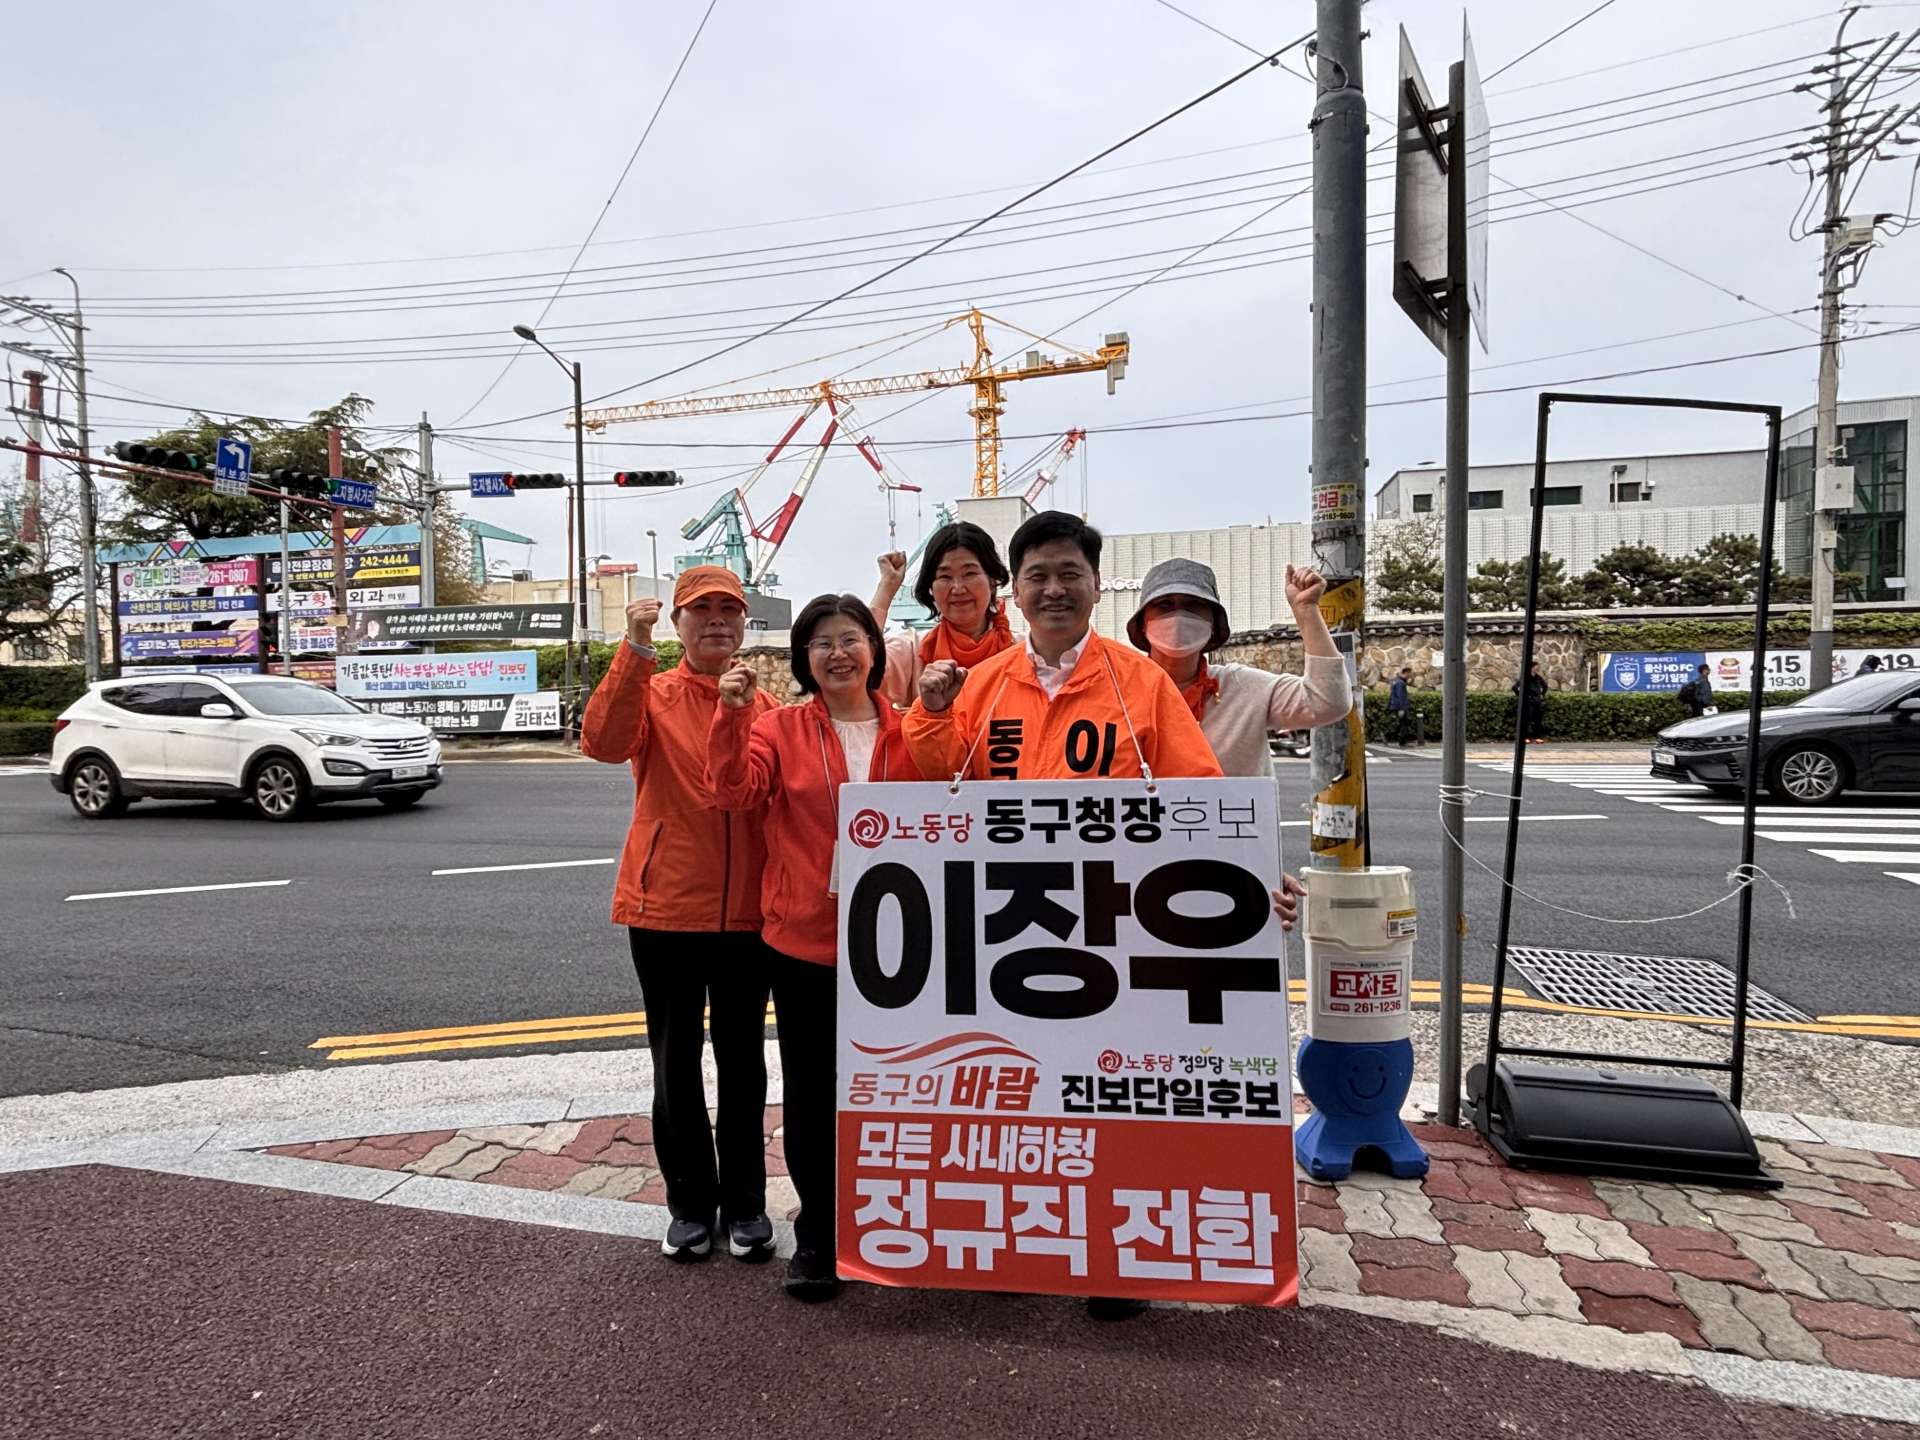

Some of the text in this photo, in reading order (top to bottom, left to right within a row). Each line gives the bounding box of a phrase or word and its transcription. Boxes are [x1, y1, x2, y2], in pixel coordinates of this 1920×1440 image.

[217, 466, 248, 480] 비보호
[359, 554, 409, 567] 242-4444
[191, 599, 216, 612] 전문의
[341, 663, 368, 680] 기름값
[370, 663, 393, 679] 폭탄!
[394, 663, 411, 677] 차는
[436, 661, 465, 677] 버스는
[466, 660, 493, 677] 답답!
[497, 663, 527, 675] 진보당
[1664, 664, 1678, 672] HD
[1680, 663, 1694, 672] FC
[1769, 676, 1805, 687] 19:30
[405, 701, 436, 714] 노동자의
[437, 700, 460, 713] 명복을
[461, 698, 507, 712] 기원합니다.
[515, 711, 557, 727] 김태선
[987, 719, 1023, 780] 동
[1065, 719, 1116, 777] 이
[891, 813, 973, 843] 노동당
[848, 859, 1281, 1025] 이장우
[1336, 973, 1398, 997] 교차로
[1124, 1053, 1278, 1076] 노동당 정의당 녹색당
[848, 1065, 1040, 1112] 동구의 바람
[1061, 1075, 1282, 1119] 진보단일후보
[857, 1121, 1096, 1177] 모든 사내하청
[854, 1178, 1279, 1286] 정규직 전환
